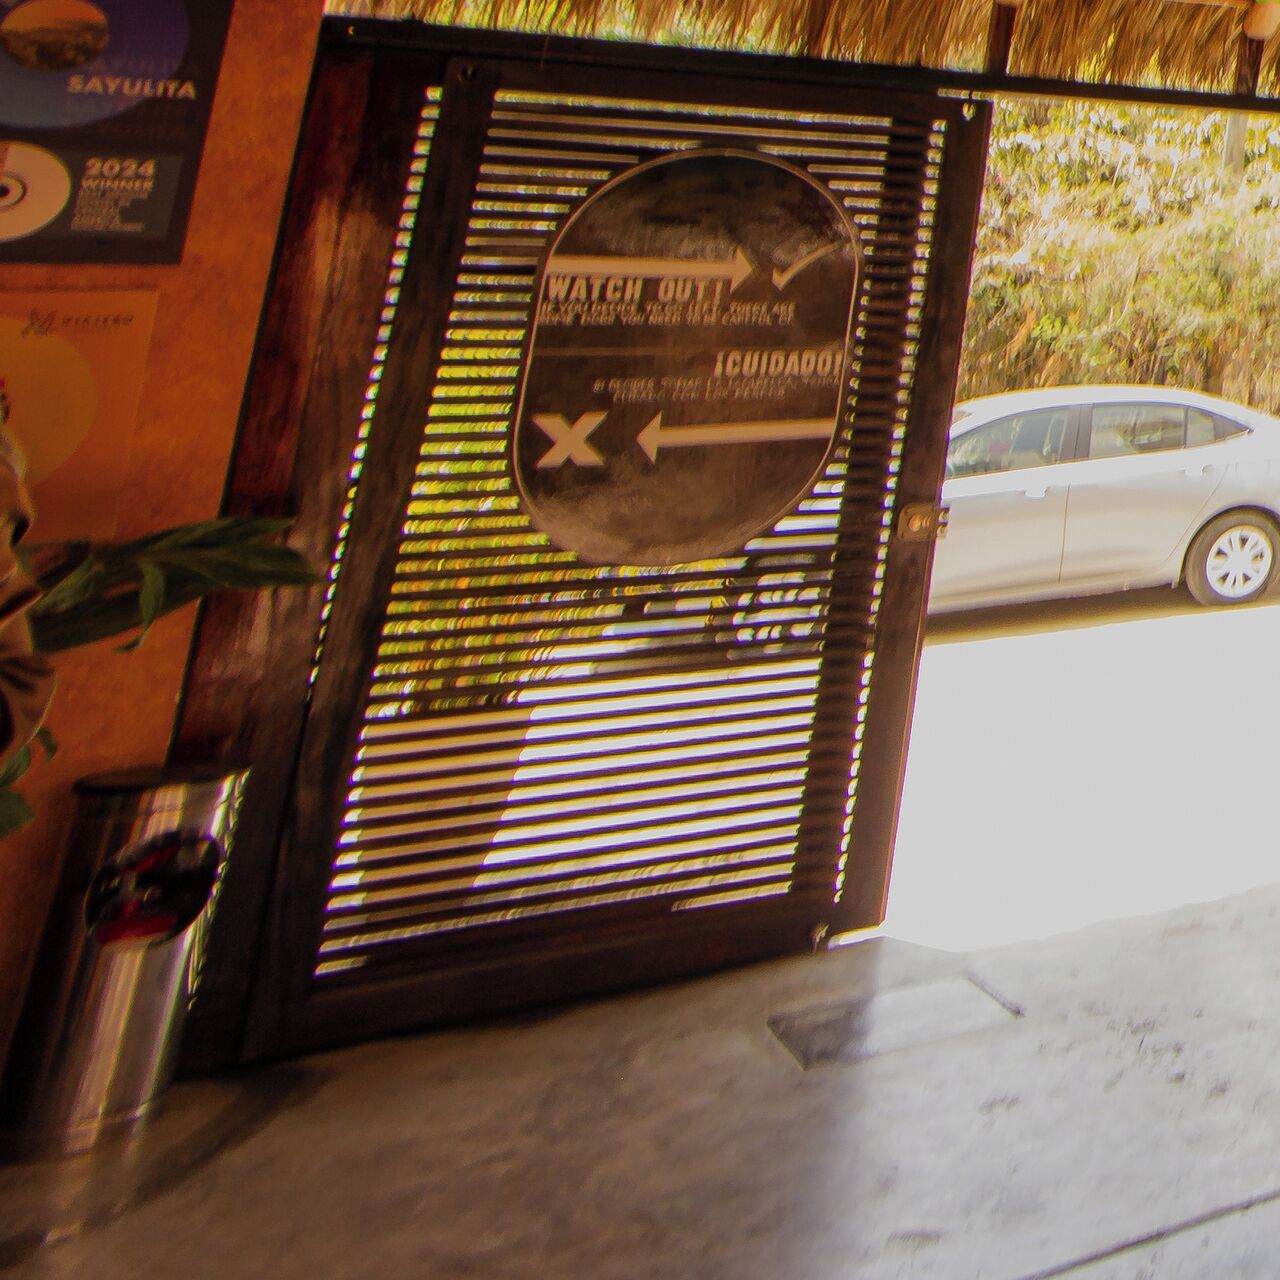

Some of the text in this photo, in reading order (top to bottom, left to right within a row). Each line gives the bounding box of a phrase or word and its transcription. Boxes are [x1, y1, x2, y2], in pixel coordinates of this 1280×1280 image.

[66, 73, 196, 101] SAYULITA
[84, 158, 155, 177] 2024
[80, 177, 154, 191] WINNER
[546, 275, 724, 305] WATCH OUT!
[714, 349, 843, 379] ¡CUIDADO!
